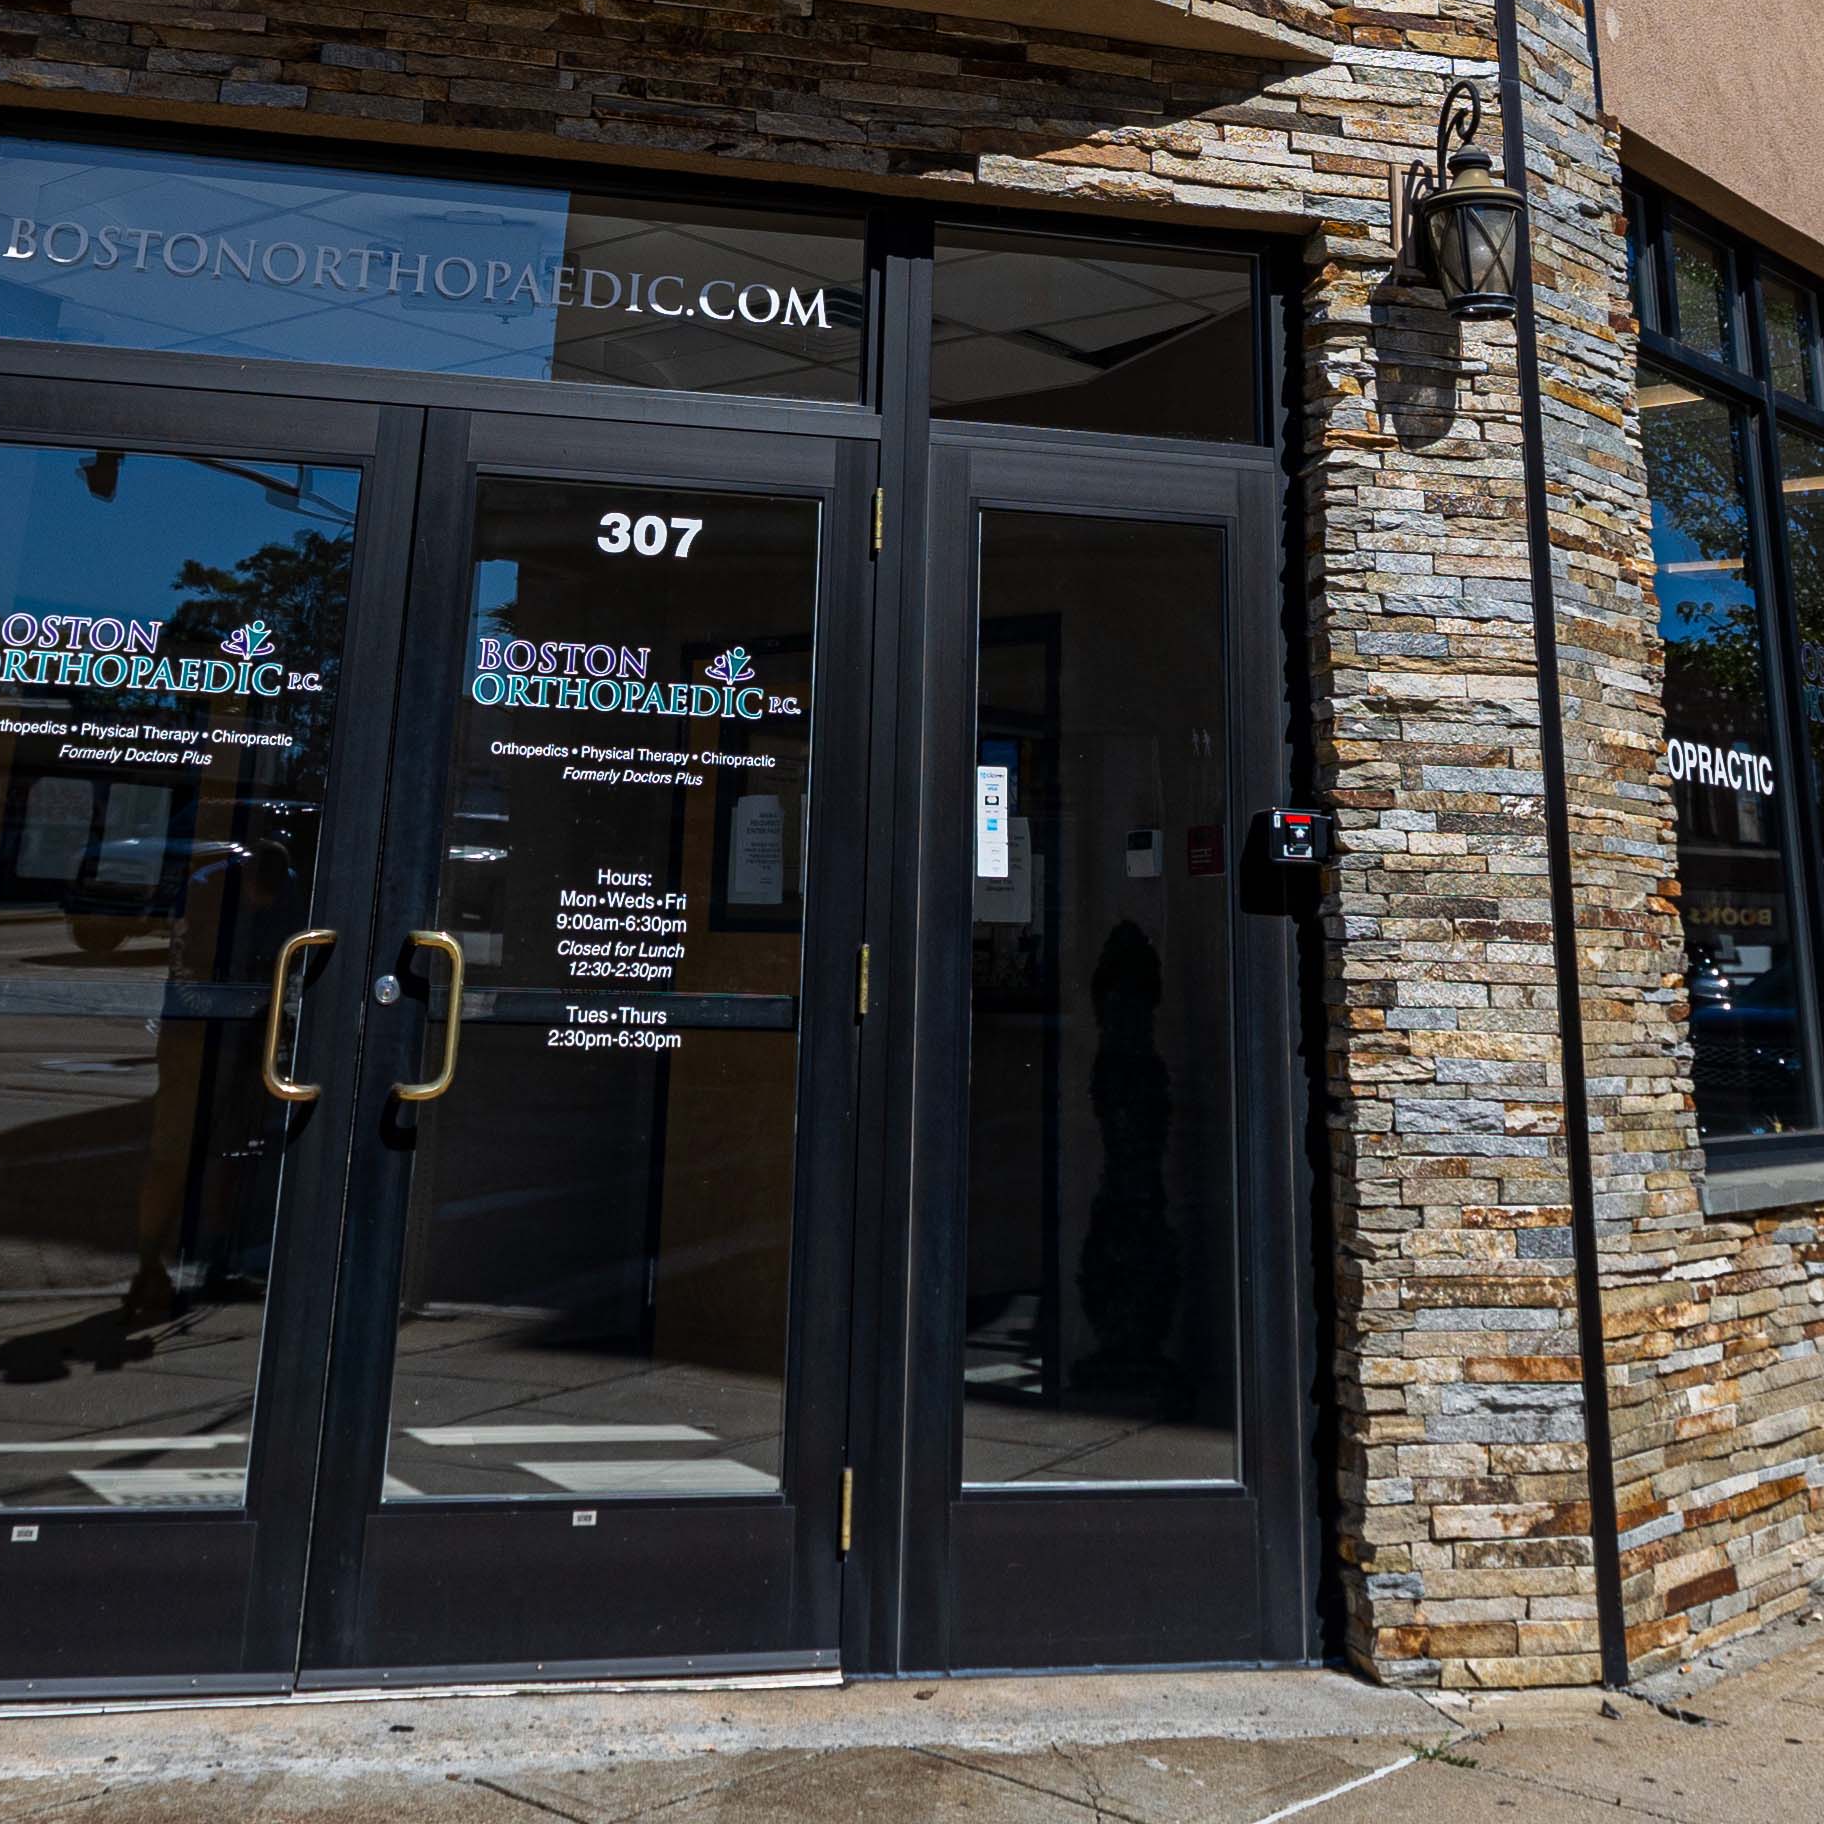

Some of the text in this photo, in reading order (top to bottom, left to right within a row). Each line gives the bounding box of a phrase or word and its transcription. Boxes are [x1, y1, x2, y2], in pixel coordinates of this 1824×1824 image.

[2, 216, 832, 330] BOSTONORTHOPAEDIC.COM
[597, 512, 703, 558] 307
[478, 638, 650, 679] BOSTON
[288, 672, 322, 691] P.C.
[472, 673, 801, 719] ORTHOPAEDIC P.C.
[81, 722, 138, 740] Physical
[143, 726, 198, 744] Therapy
[212, 729, 292, 747] Chiropractic
[59, 744, 212, 766] Formerly Doctors Plus
[491, 741, 776, 768] Orthopedics Physical Therapy Chiropractic
[563, 766, 703, 786] Formerly Doctors Plus
[598, 869, 652, 886] Hours:
[556, 913, 687, 935] 9:00am-6:30pm
[557, 940, 685, 958] Closed for Lunch
[569, 961, 672, 981] 12:30-2:30pm
[548, 1029, 681, 1051] 2:30pm-6:30pm
